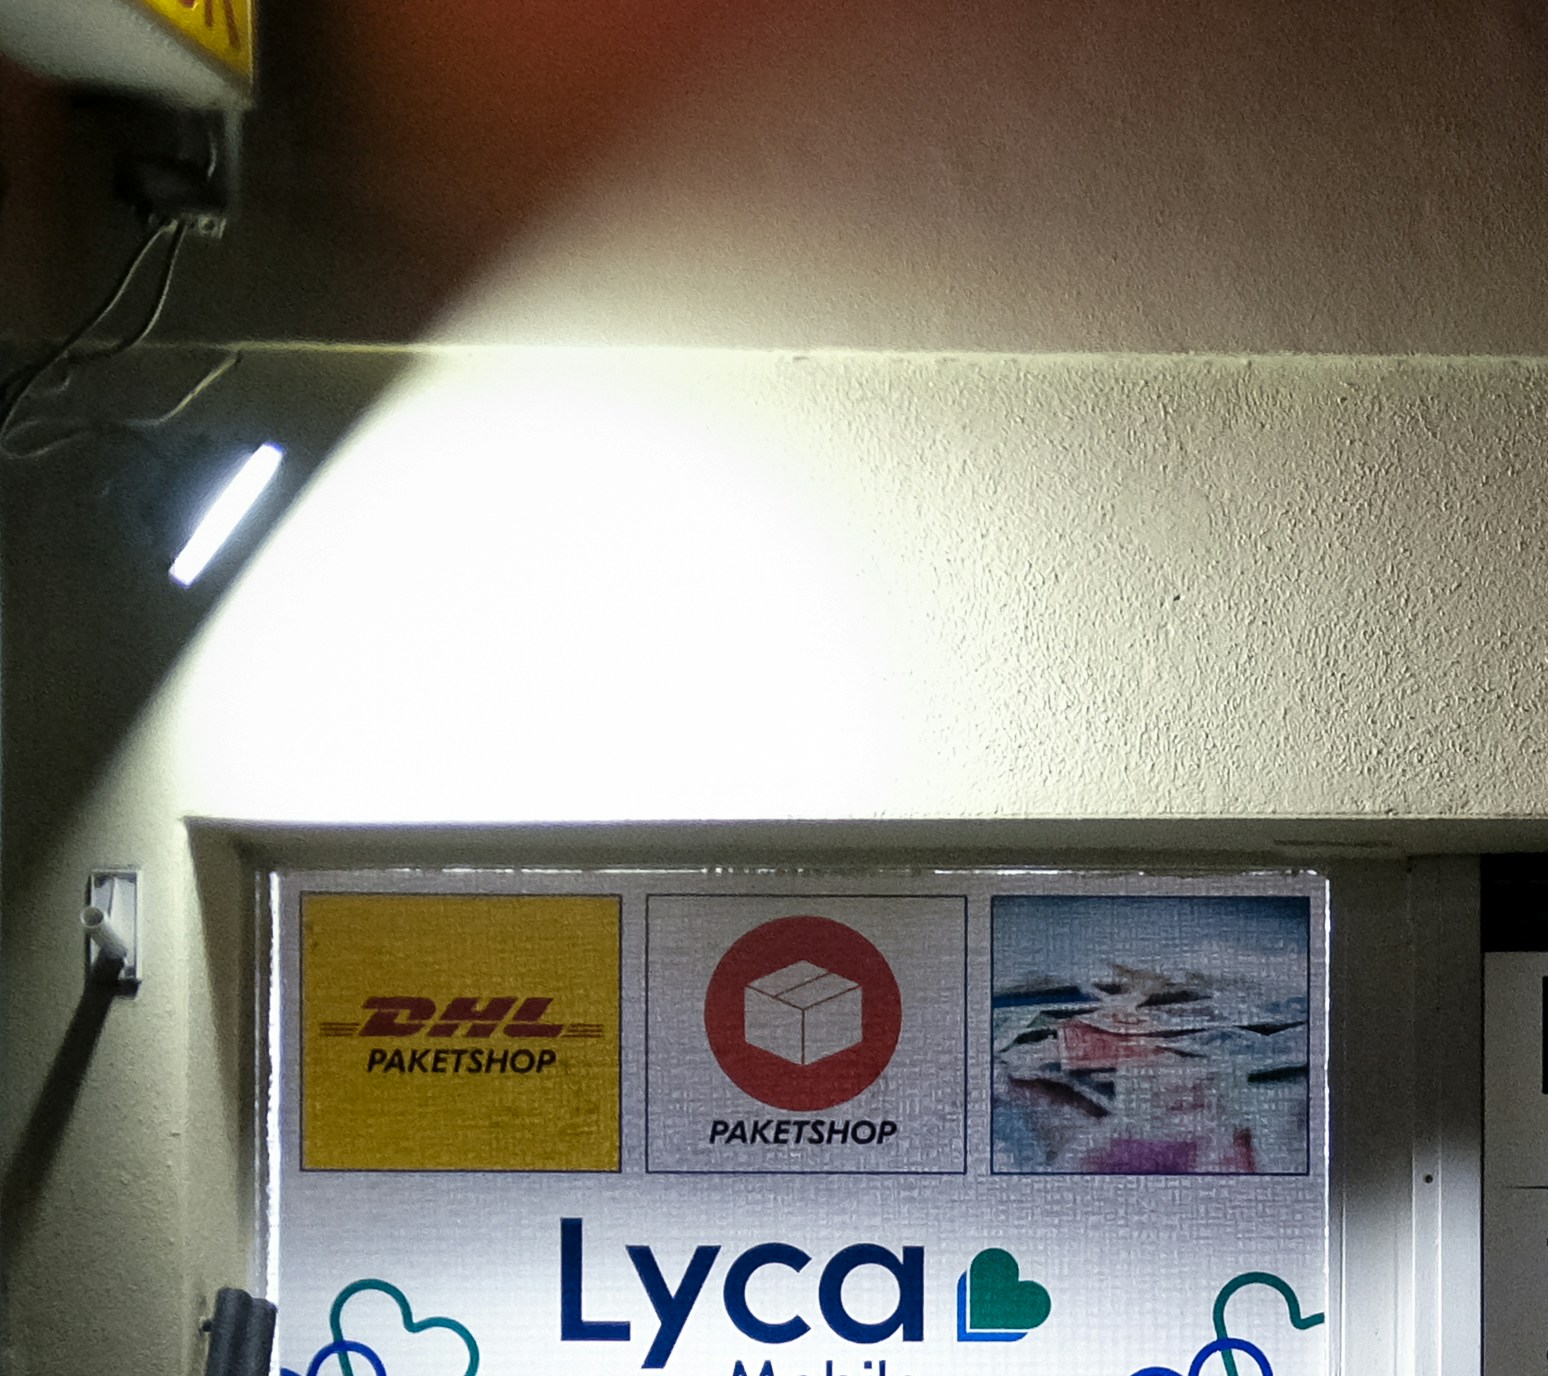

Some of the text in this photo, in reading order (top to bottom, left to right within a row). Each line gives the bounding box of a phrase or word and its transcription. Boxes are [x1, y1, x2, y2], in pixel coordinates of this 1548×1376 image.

[360, 996, 566, 1037] DHL
[367, 1047, 556, 1076] PAKETSHOP
[708, 1118, 898, 1146] PAKETSHOP
[561, 1216, 926, 1368] Lyca
